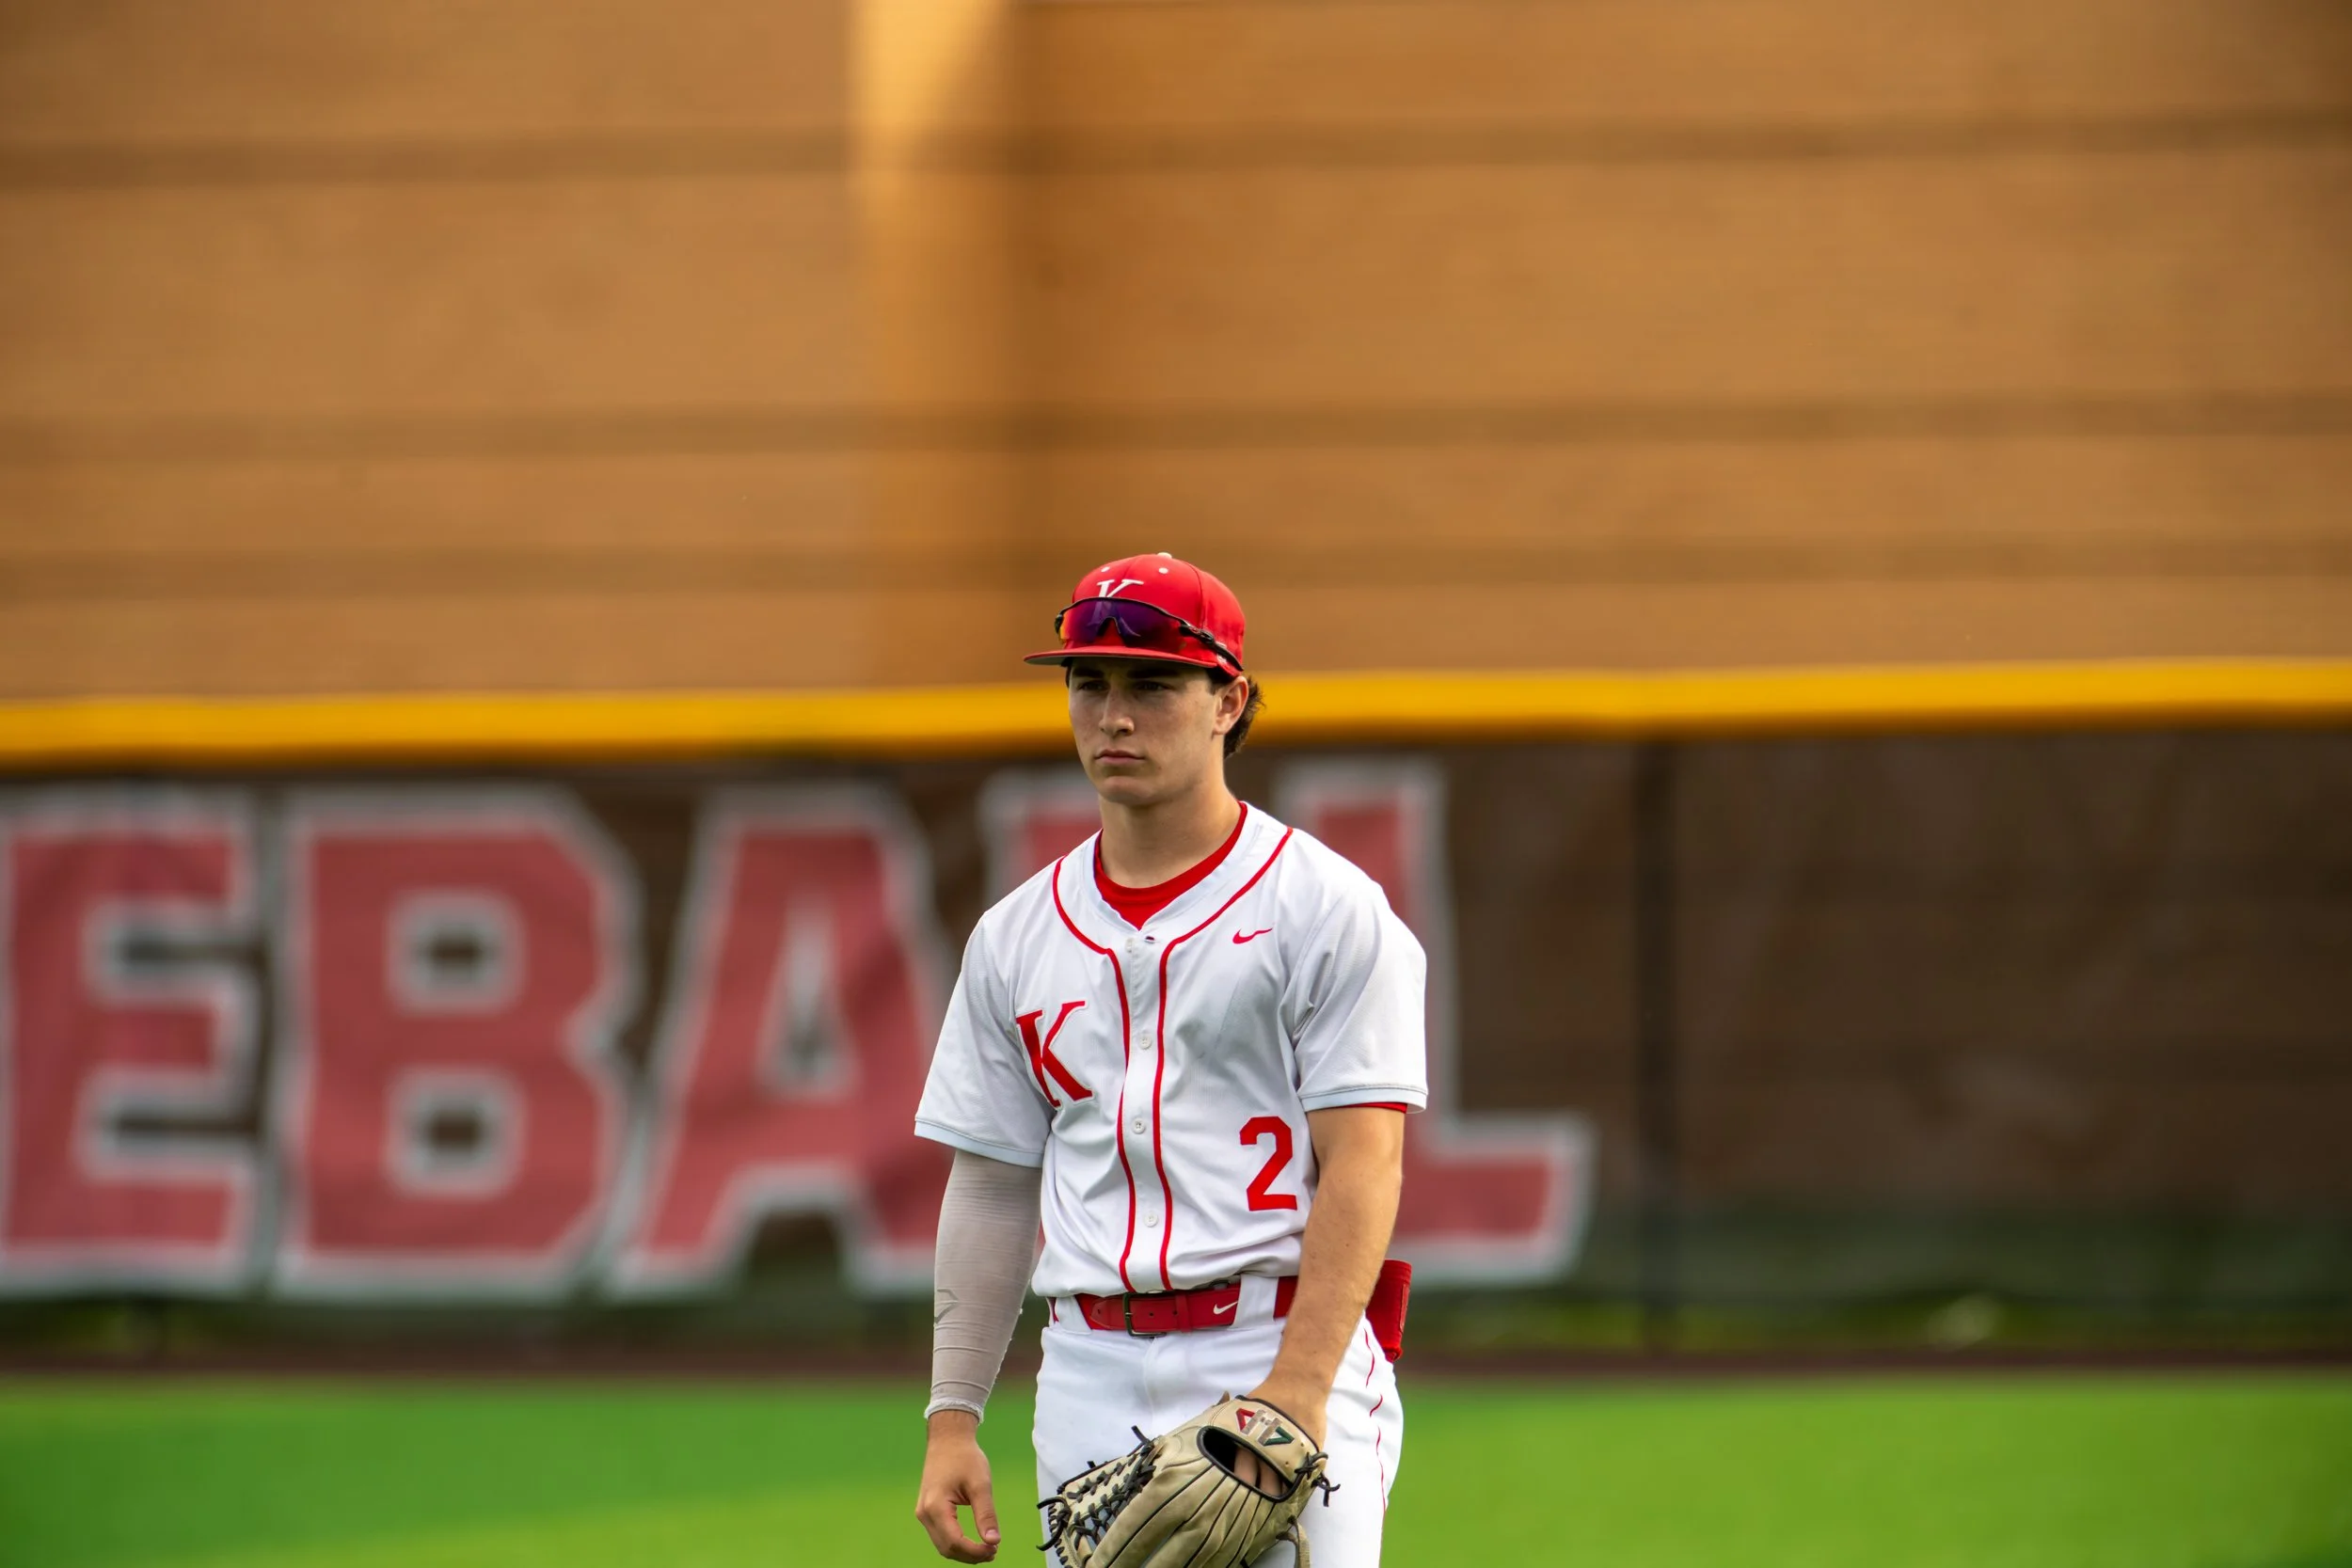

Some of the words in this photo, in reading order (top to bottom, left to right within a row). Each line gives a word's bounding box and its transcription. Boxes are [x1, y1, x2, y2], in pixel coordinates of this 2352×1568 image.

[0, 764, 1590, 1300] EBAL
[1015, 1000, 1094, 1108] K
[1239, 1116, 1298, 1212] 2
